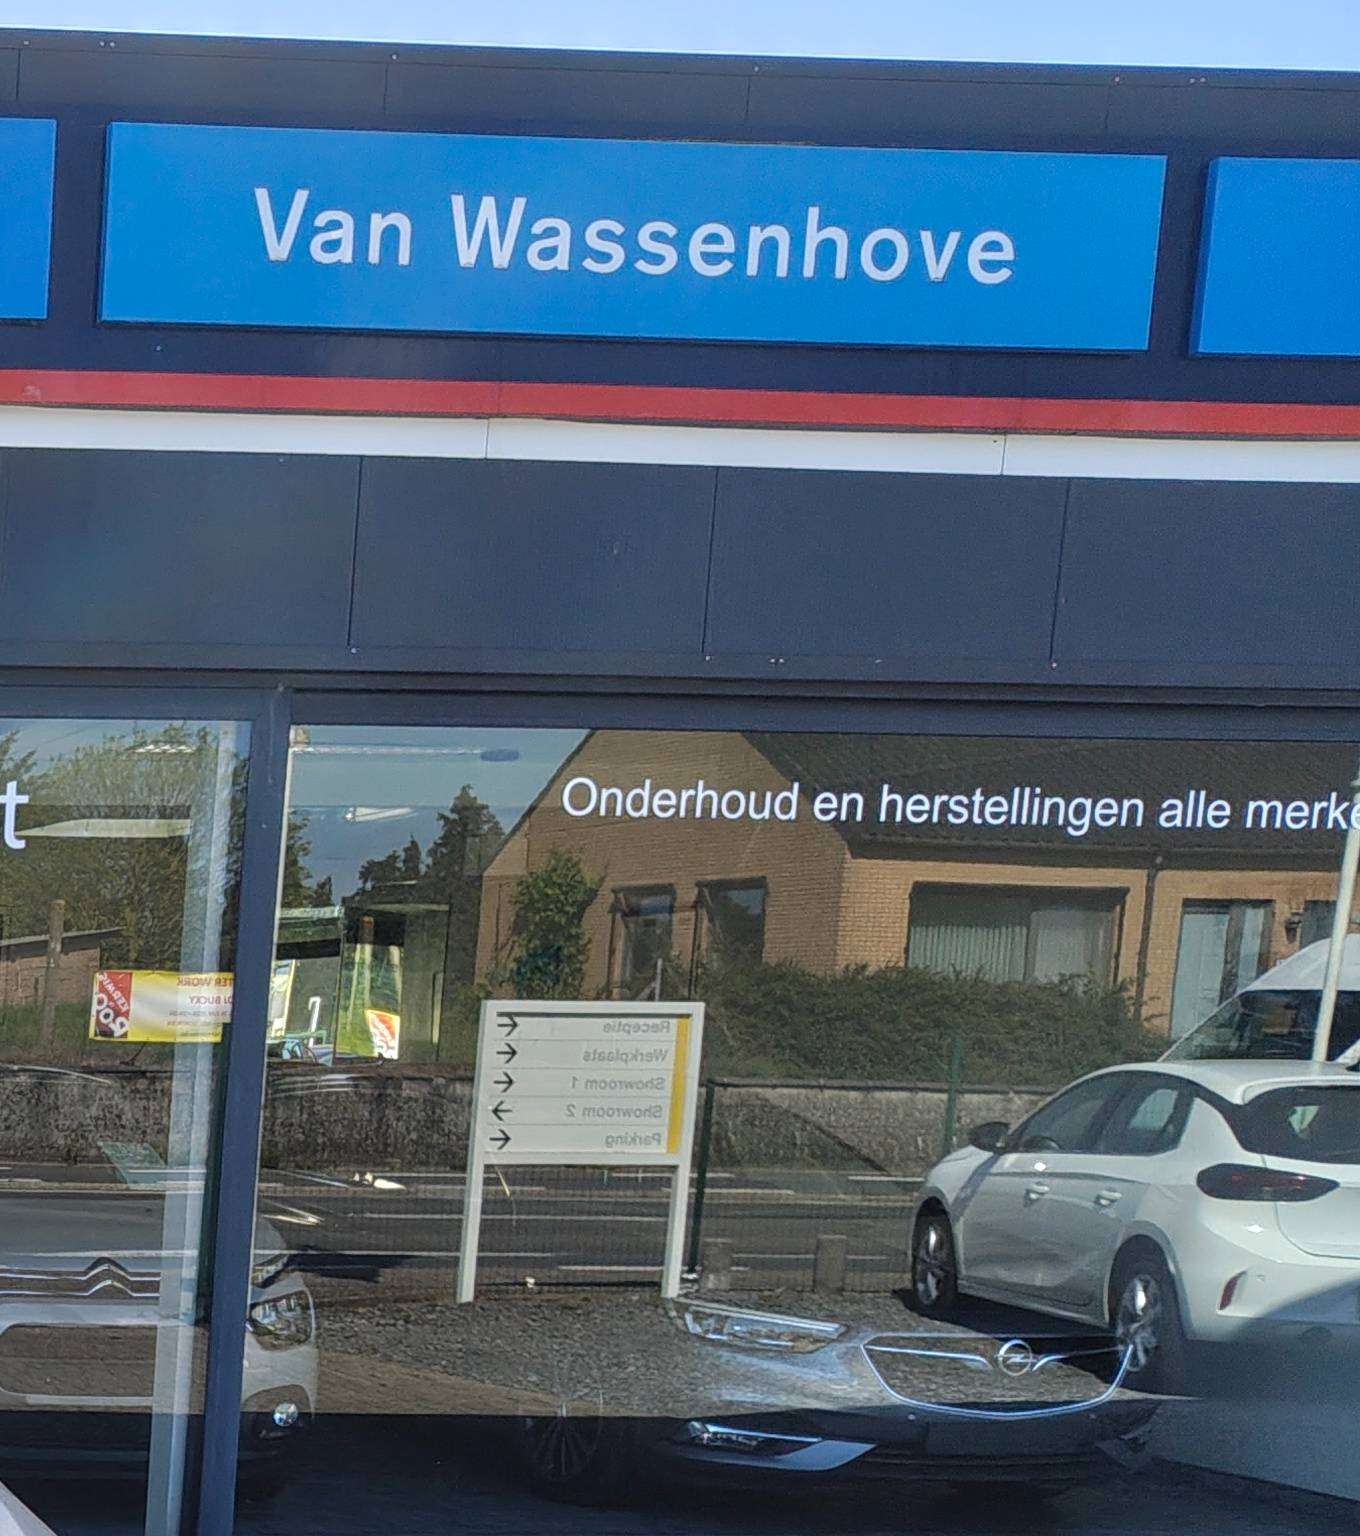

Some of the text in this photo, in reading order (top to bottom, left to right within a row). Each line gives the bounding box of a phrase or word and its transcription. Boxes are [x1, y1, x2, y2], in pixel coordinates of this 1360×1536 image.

[253, 185, 1017, 286] Van Wassenhove
[562, 777, 799, 823] Onderhoud
[813, 789, 864, 822] en
[879, 783, 1148, 836] herstellingen
[1159, 789, 1231, 829] alle
